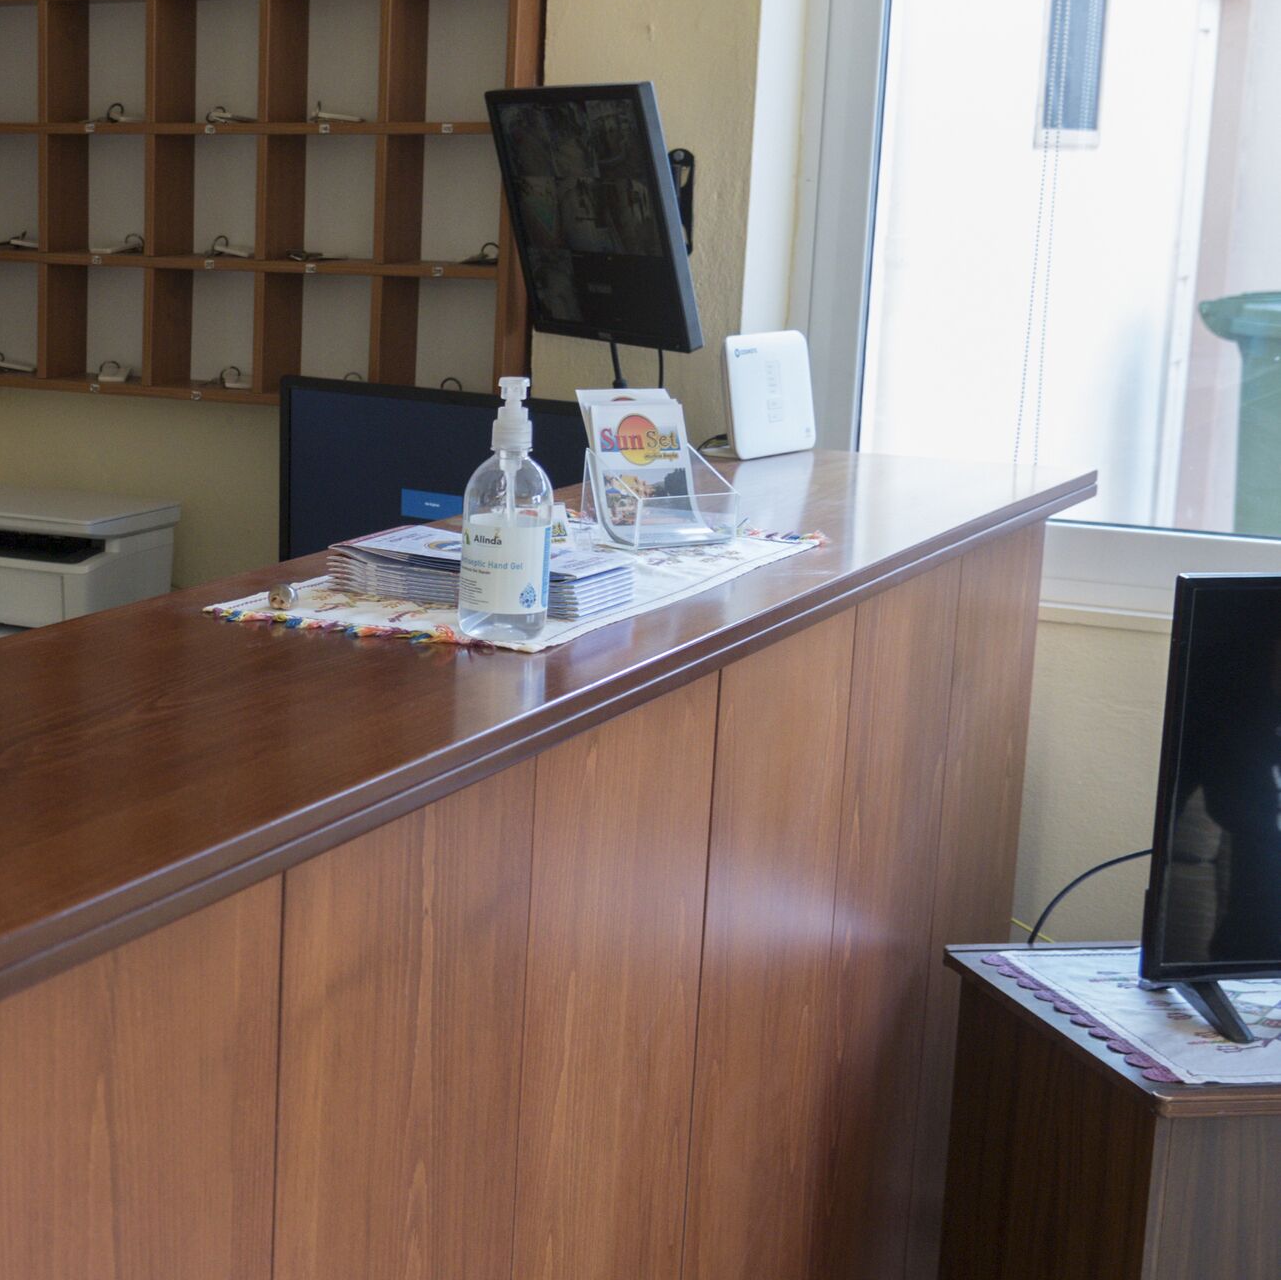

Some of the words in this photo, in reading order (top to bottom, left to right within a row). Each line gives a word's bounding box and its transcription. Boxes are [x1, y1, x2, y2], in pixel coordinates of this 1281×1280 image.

[600, 427, 644, 451] Sun
[646, 429, 678, 449] Set
[474, 534, 502, 546] Alinda
[488, 561, 508, 570] Hand
[510, 562, 523, 570] Gel
